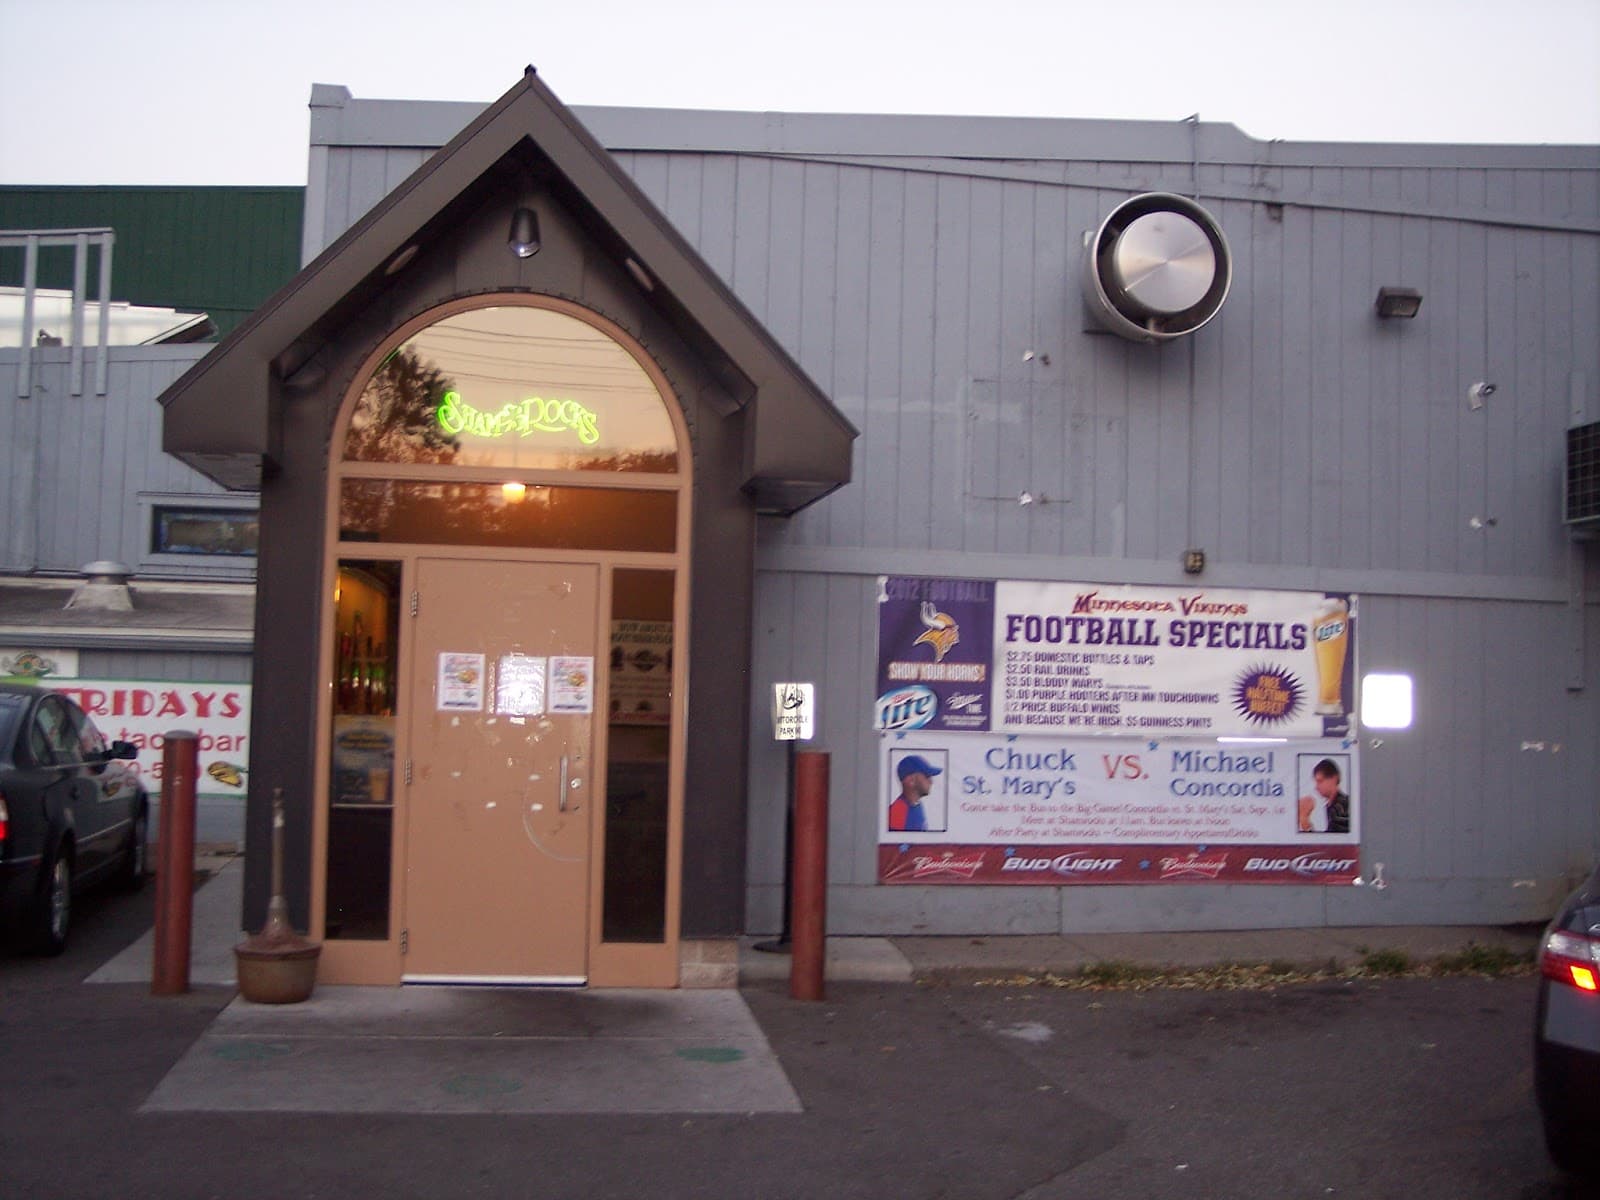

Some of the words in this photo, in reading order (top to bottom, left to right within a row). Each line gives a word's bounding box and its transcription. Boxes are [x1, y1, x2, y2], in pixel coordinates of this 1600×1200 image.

[1006, 614, 1160, 646] FOOTBALL
[1170, 620, 1307, 650] SPECIALS
[1034, 652, 1080, 663] DOMESTIC
[1083, 653, 1120, 664] BOTTLES
[1122, 654, 1130, 664] &
[1133, 654, 1155, 665] TAPS
[889, 662, 919, 680] SHOW
[1034, 664, 1053, 675] RAIL
[1057, 665, 1090, 676] DRINKS
[1034, 677, 1068, 687] BLOODY
[1032, 689, 1066, 700] PURPLE
[1069, 690, 1109, 701] HOOTERS
[1112, 691, 1138, 701] AFTER
[1159, 692, 1219, 704] TOUCHDOWNS
[1021, 702, 1047, 712] PRICE
[1050, 702, 1088, 713] BUFFALO
[1091, 703, 1120, 714] WINGS
[1005, 714, 1023, 724] AND
[1026, 714, 1065, 725] BECAUSE
[1140, 716, 1184, 727] GUINNESS
[1186, 717, 1212, 728] PINTS
[199, 728, 247, 752] bar
[986, 748, 1076, 770] Chuck
[1171, 751, 1274, 773] Michael
[962, 775, 992, 794] St.
[1002, 776, 1076, 800] Mary's
[1170, 778, 1284, 797] Concordia
